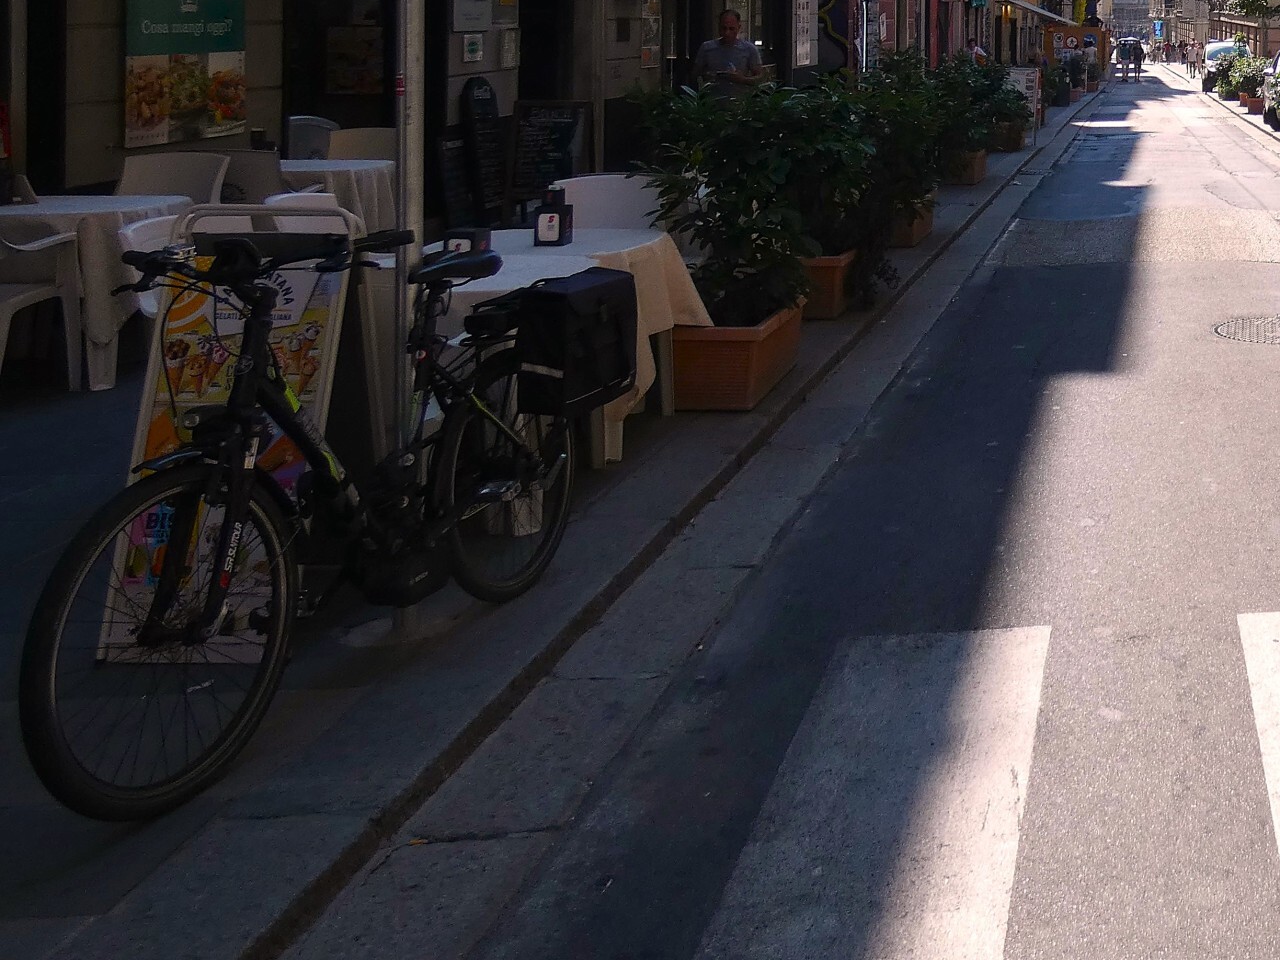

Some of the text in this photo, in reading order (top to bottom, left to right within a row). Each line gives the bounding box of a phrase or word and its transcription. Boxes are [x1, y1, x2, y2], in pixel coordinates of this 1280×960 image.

[141, 18, 233, 37] Cosa mangi oggi?
[214, 312, 239, 321] GELATI
[227, 521, 243, 558] SUNTOUR
